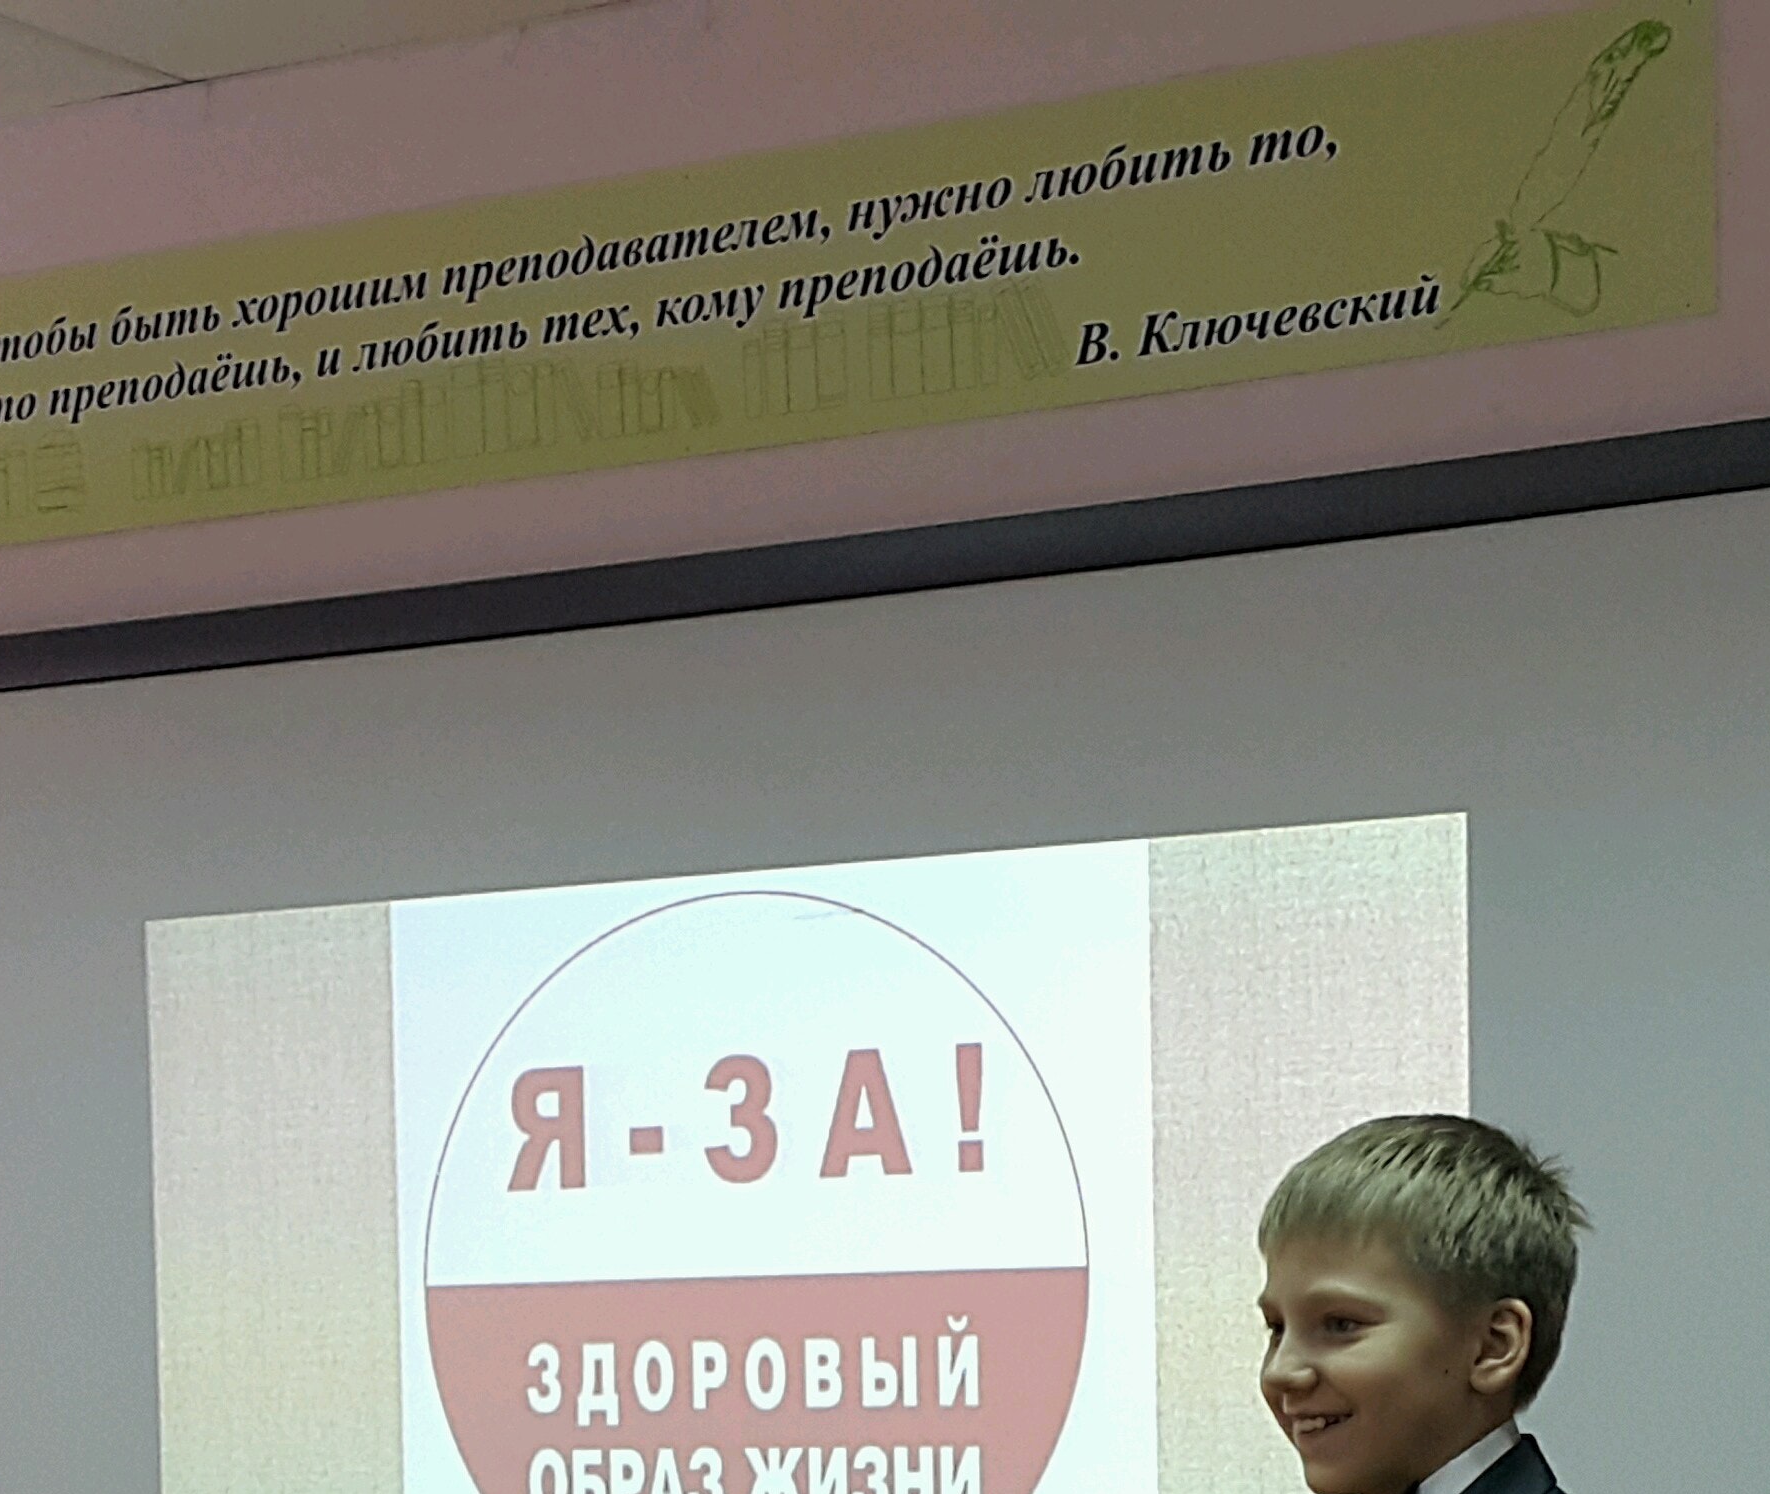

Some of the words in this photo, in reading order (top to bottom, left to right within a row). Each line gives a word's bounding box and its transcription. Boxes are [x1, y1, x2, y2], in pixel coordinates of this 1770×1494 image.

[110, 303, 221, 347] быть
[230, 271, 428, 334] хорошим
[440, 208, 832, 305] преподавателем,
[847, 176, 1013, 242] нужно
[1023, 141, 1232, 204] любить
[1248, 124, 1338, 167] то,
[48, 351, 303, 426] преподаёшь,
[316, 347, 342, 379] и
[351, 320, 529, 373] любить
[541, 303, 640, 346] тех,
[655, 283, 766, 330] кому
[777, 233, 1081, 320] преподаёшь.
[1074, 321, 1121, 367] В.
[1136, 273, 1441, 358] Ключевский
[525, 1314, 981, 1427] ЗДОРОВЫЙ
